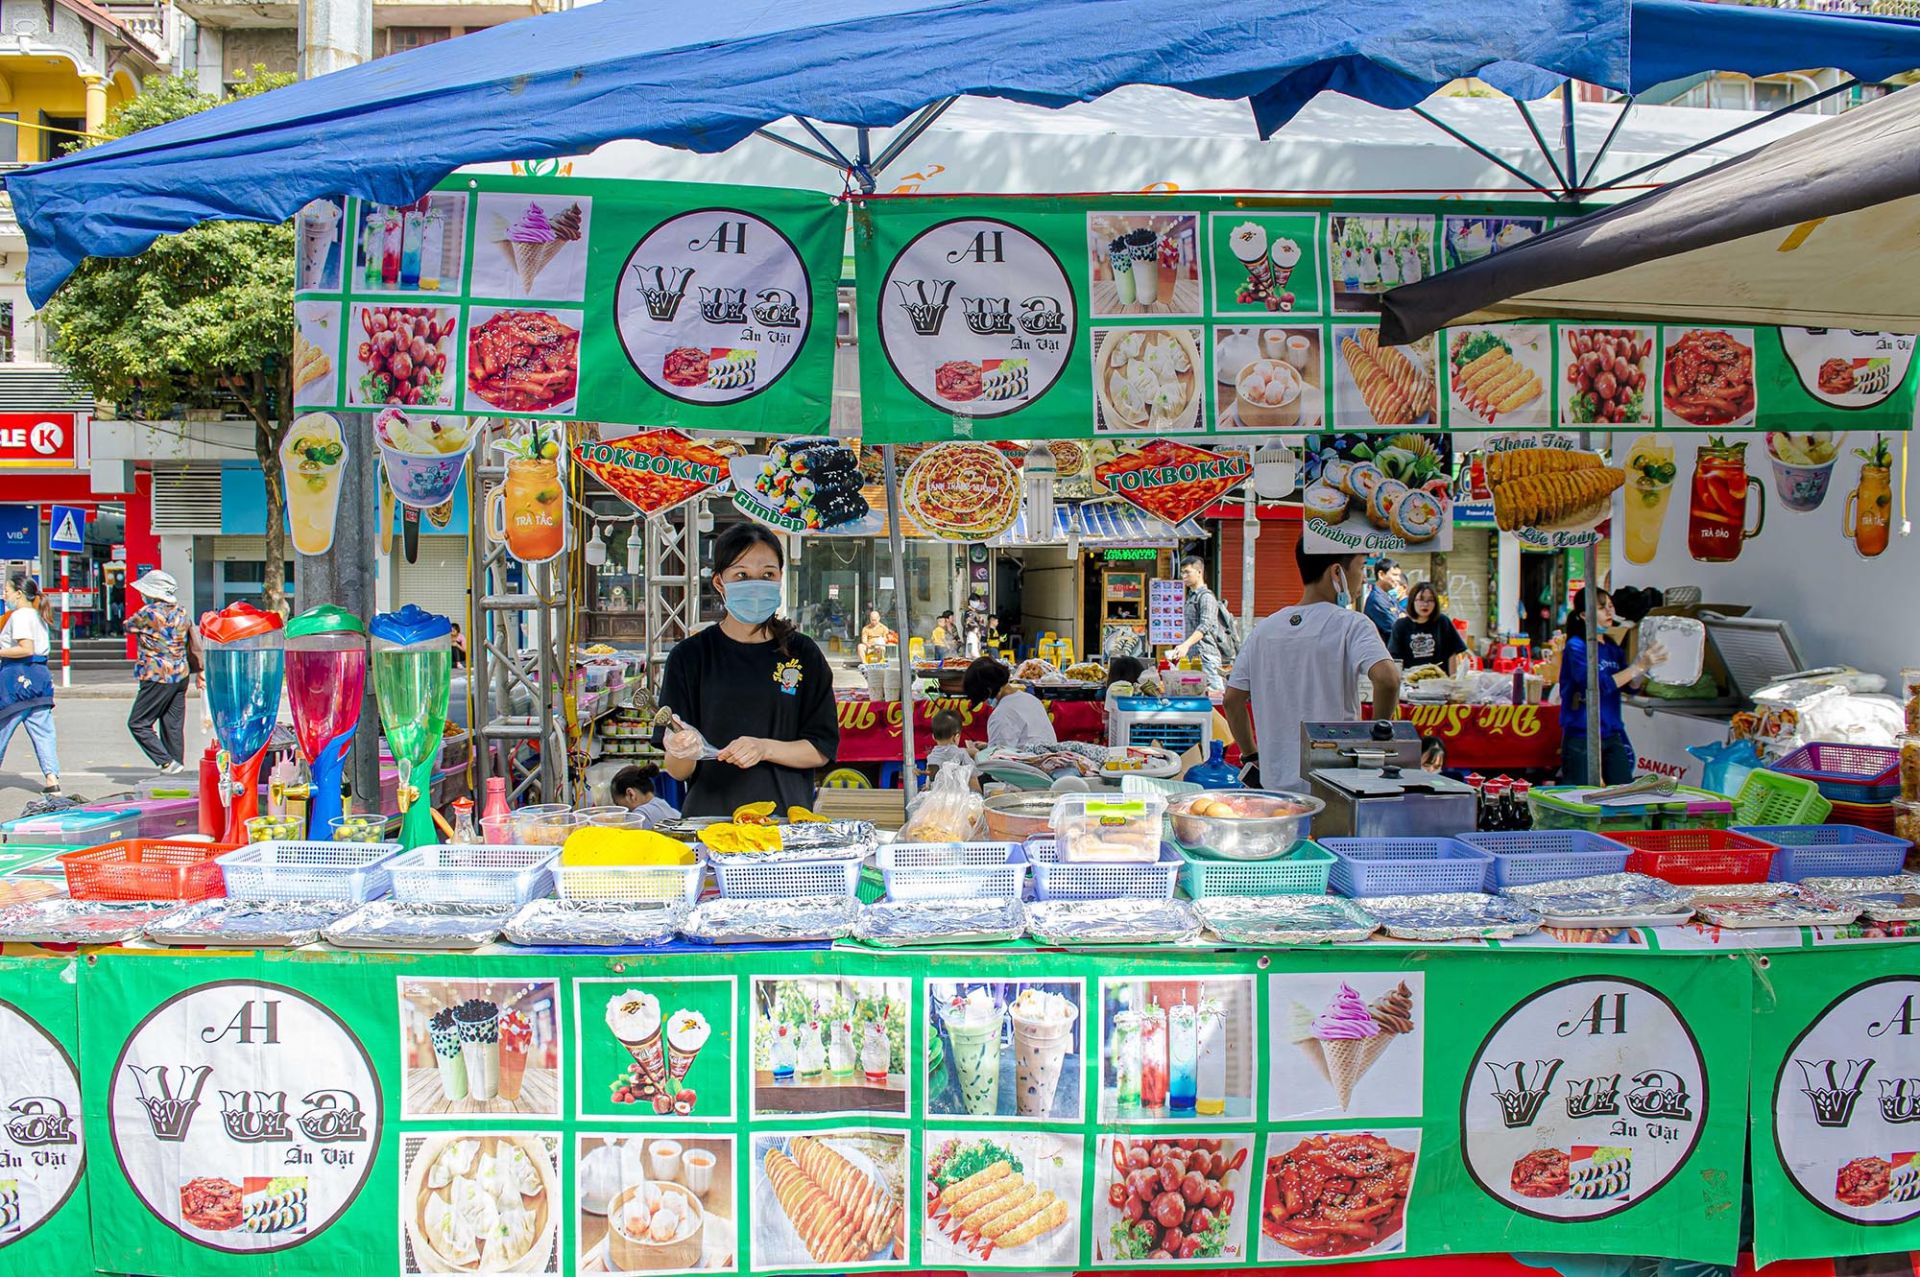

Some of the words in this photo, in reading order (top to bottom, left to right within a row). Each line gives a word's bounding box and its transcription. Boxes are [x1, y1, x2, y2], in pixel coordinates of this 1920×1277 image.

[1488, 436, 1537, 453] Khoai
[581, 442, 720, 484] TOKBOKKI
[1105, 457, 1246, 492] TOKBOKKI
[515, 512, 533, 527] TRÀ
[733, 489, 807, 533] Gimbap
[7, 531, 23, 540] VIB
[1308, 517, 1362, 549] Gimbap
[1365, 533, 1405, 550] Chiên
[1637, 757, 1688, 780] SANAKY
[1867, 994, 1920, 1038] A
[1794, 1057, 1920, 1128] Vu
[1645, 1122, 1680, 1142] Vật
[31, 1151, 67, 1170] Vật
[321, 1147, 355, 1169] Vật
